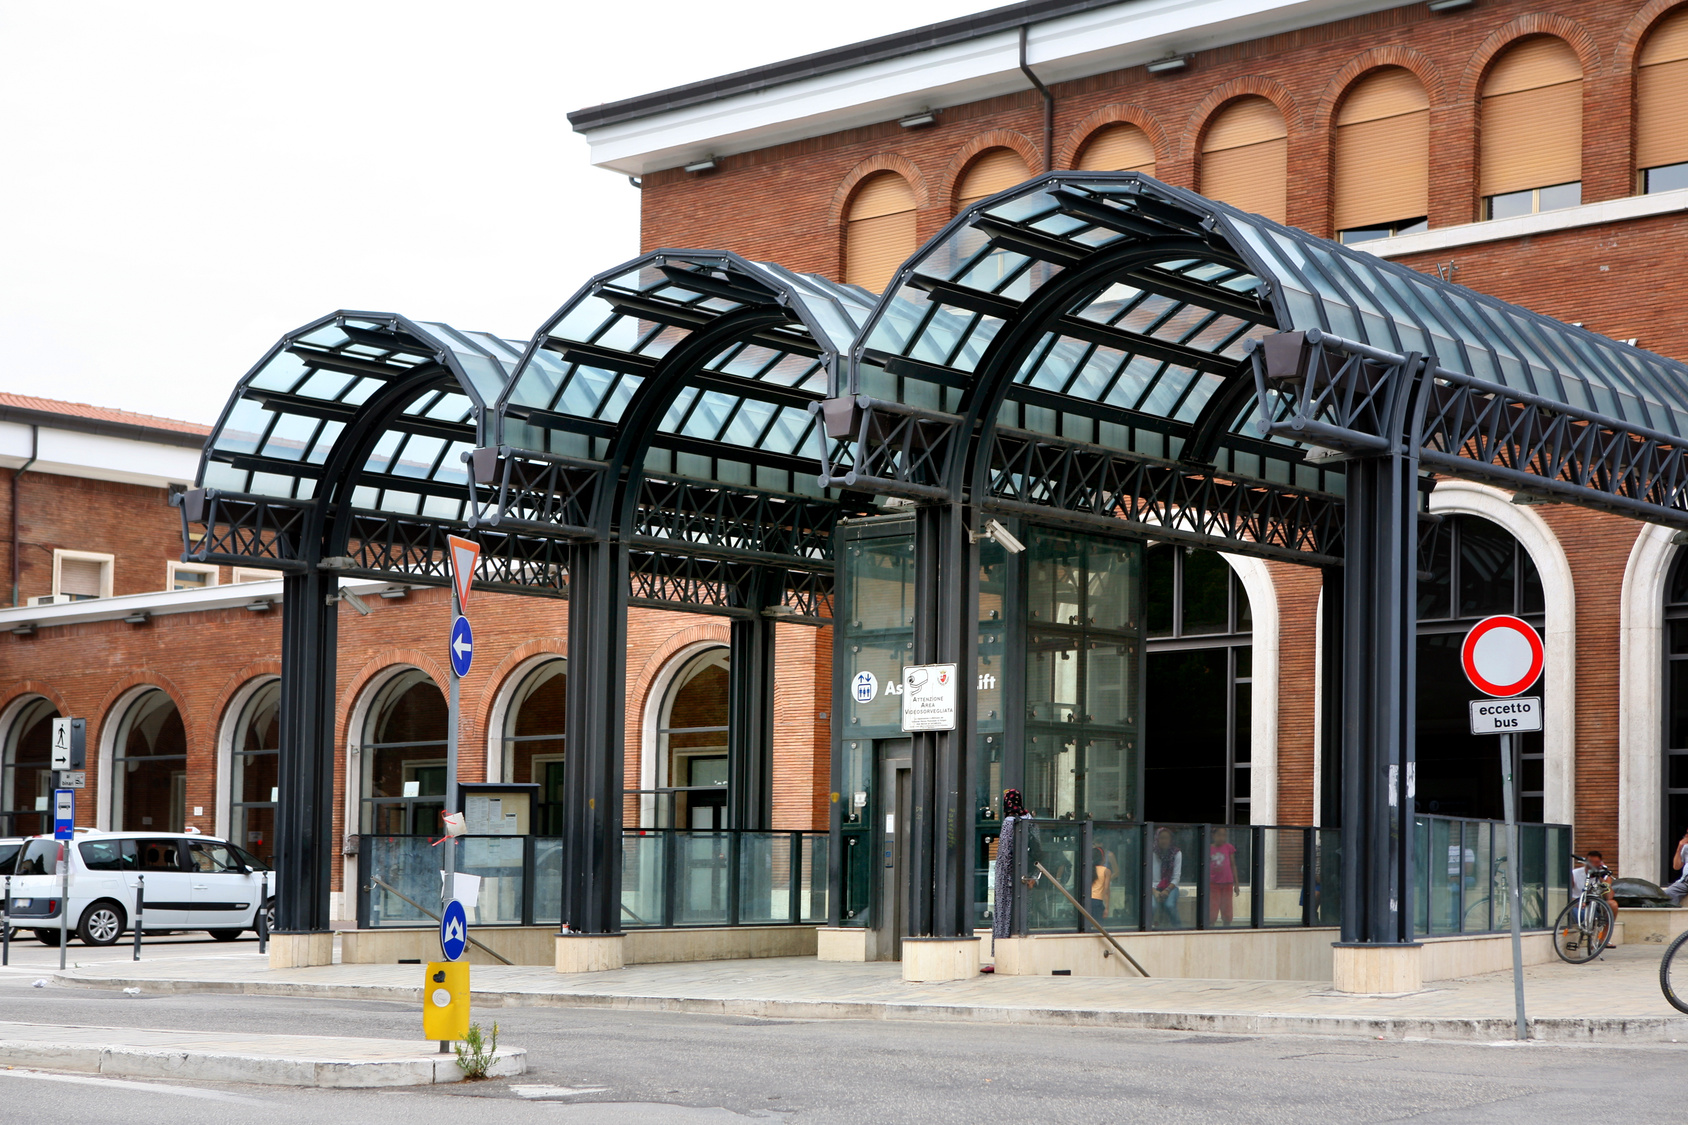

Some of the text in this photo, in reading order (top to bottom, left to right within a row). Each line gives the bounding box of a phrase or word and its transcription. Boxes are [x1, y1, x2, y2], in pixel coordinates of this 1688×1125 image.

[976, 673, 996, 690] ift
[1479, 703, 1531, 715] eccetto
[1494, 717, 1519, 728] bus
